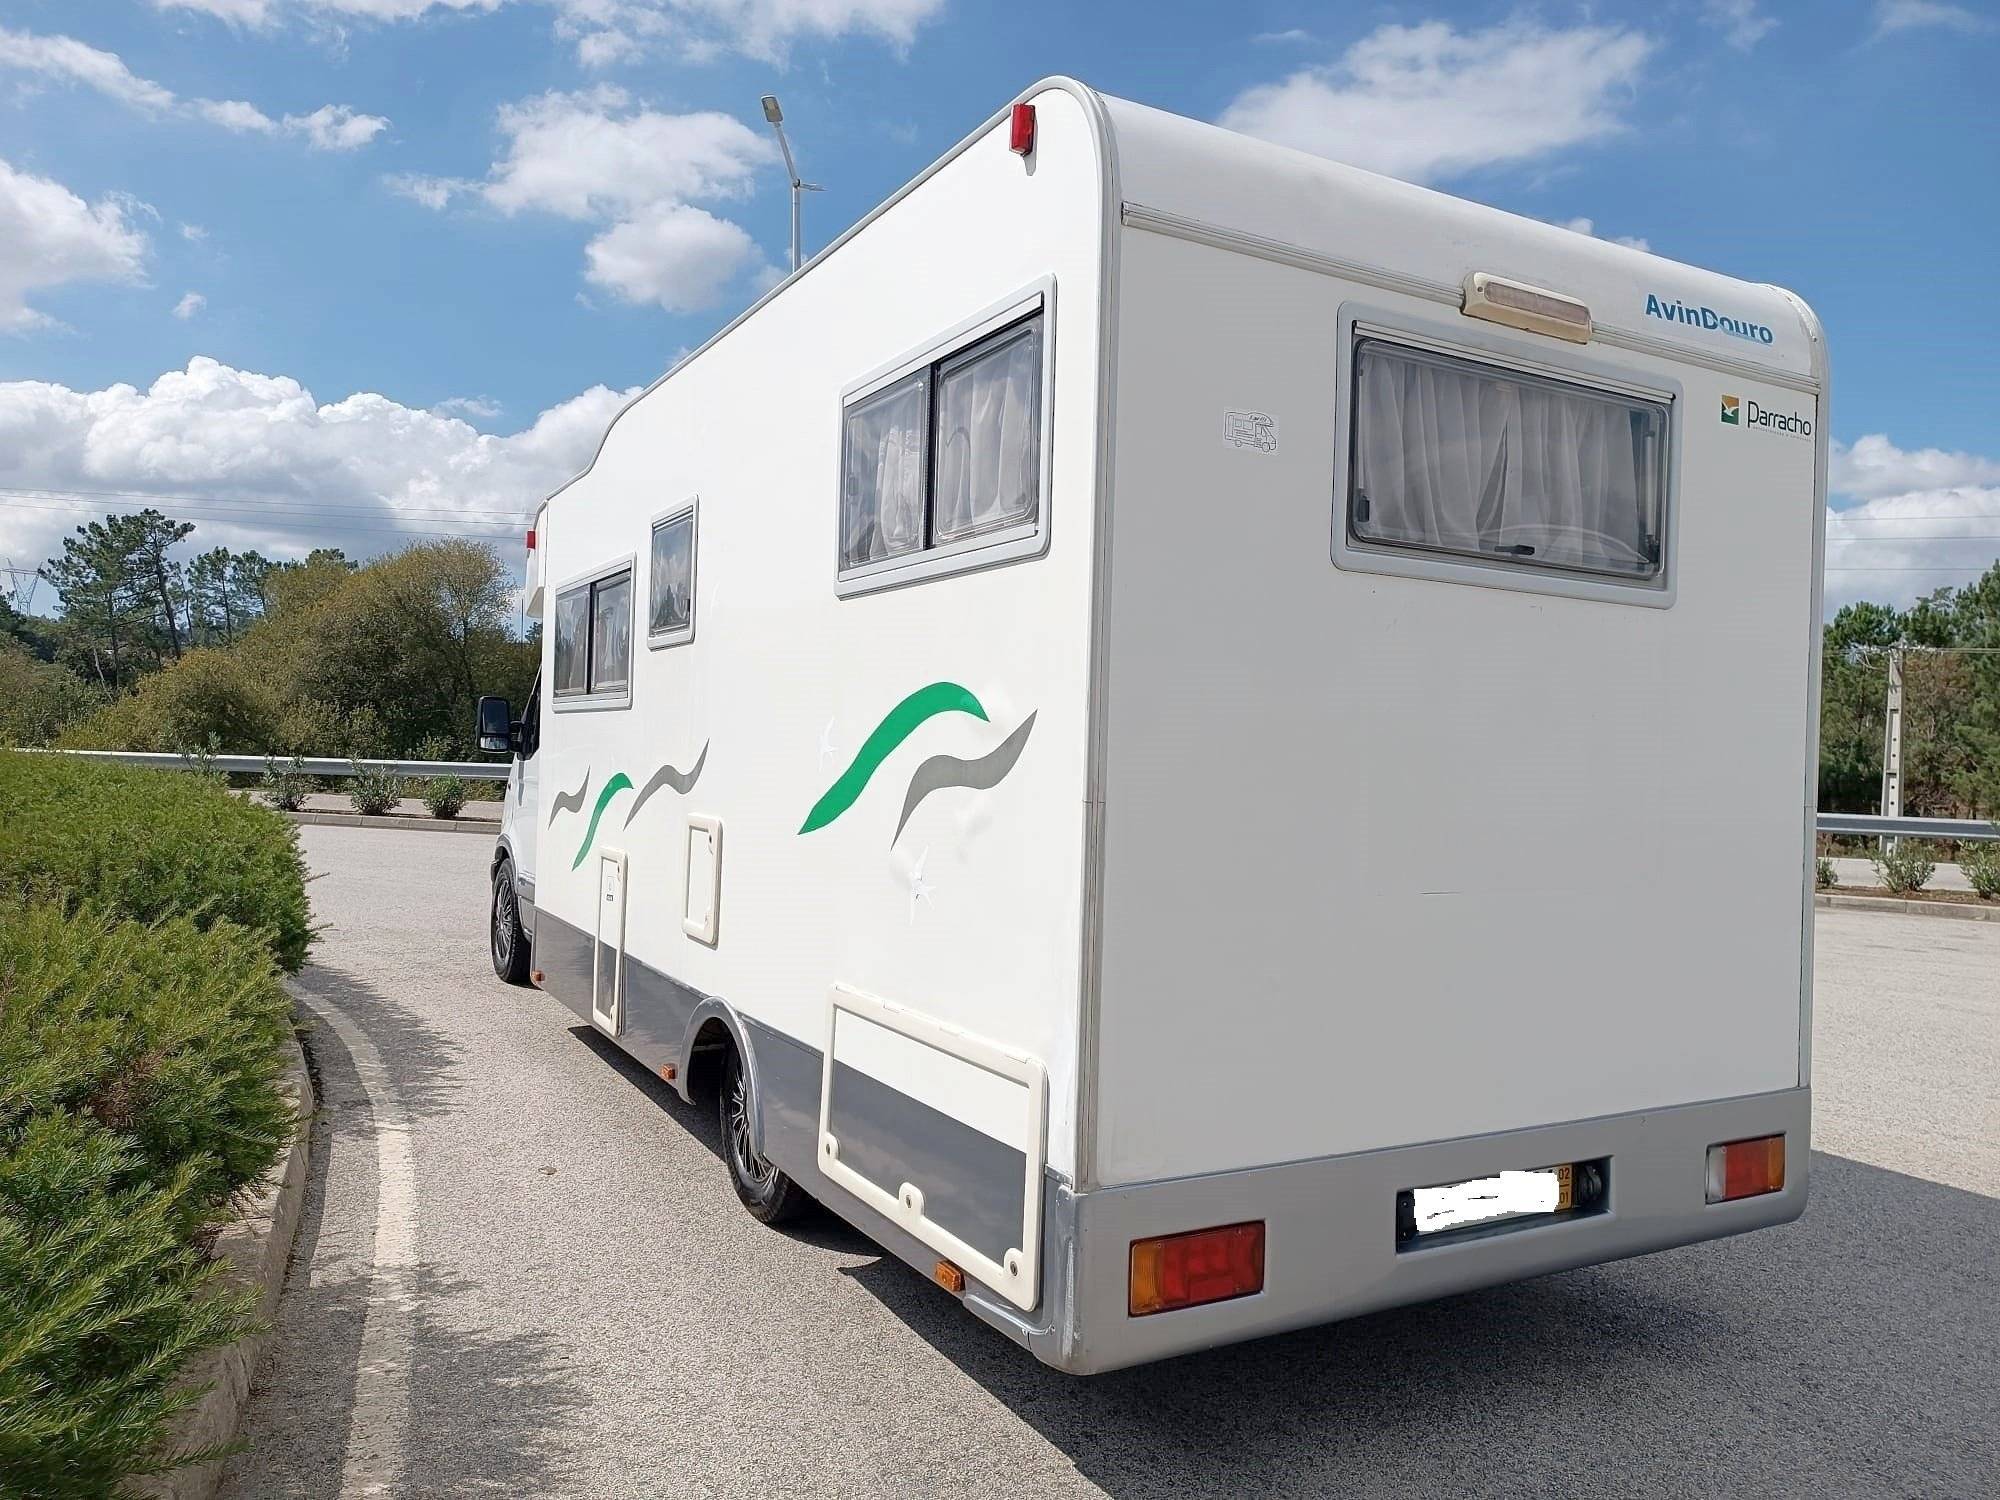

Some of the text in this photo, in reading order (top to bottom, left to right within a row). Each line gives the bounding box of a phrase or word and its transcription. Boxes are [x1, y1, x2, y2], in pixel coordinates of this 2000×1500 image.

[1645, 293, 1774, 344] AvinDouro
[1747, 400, 1812, 436] Parracho
[1558, 1167, 1571, 1180] 02
[1559, 1191, 1570, 1204] 01
